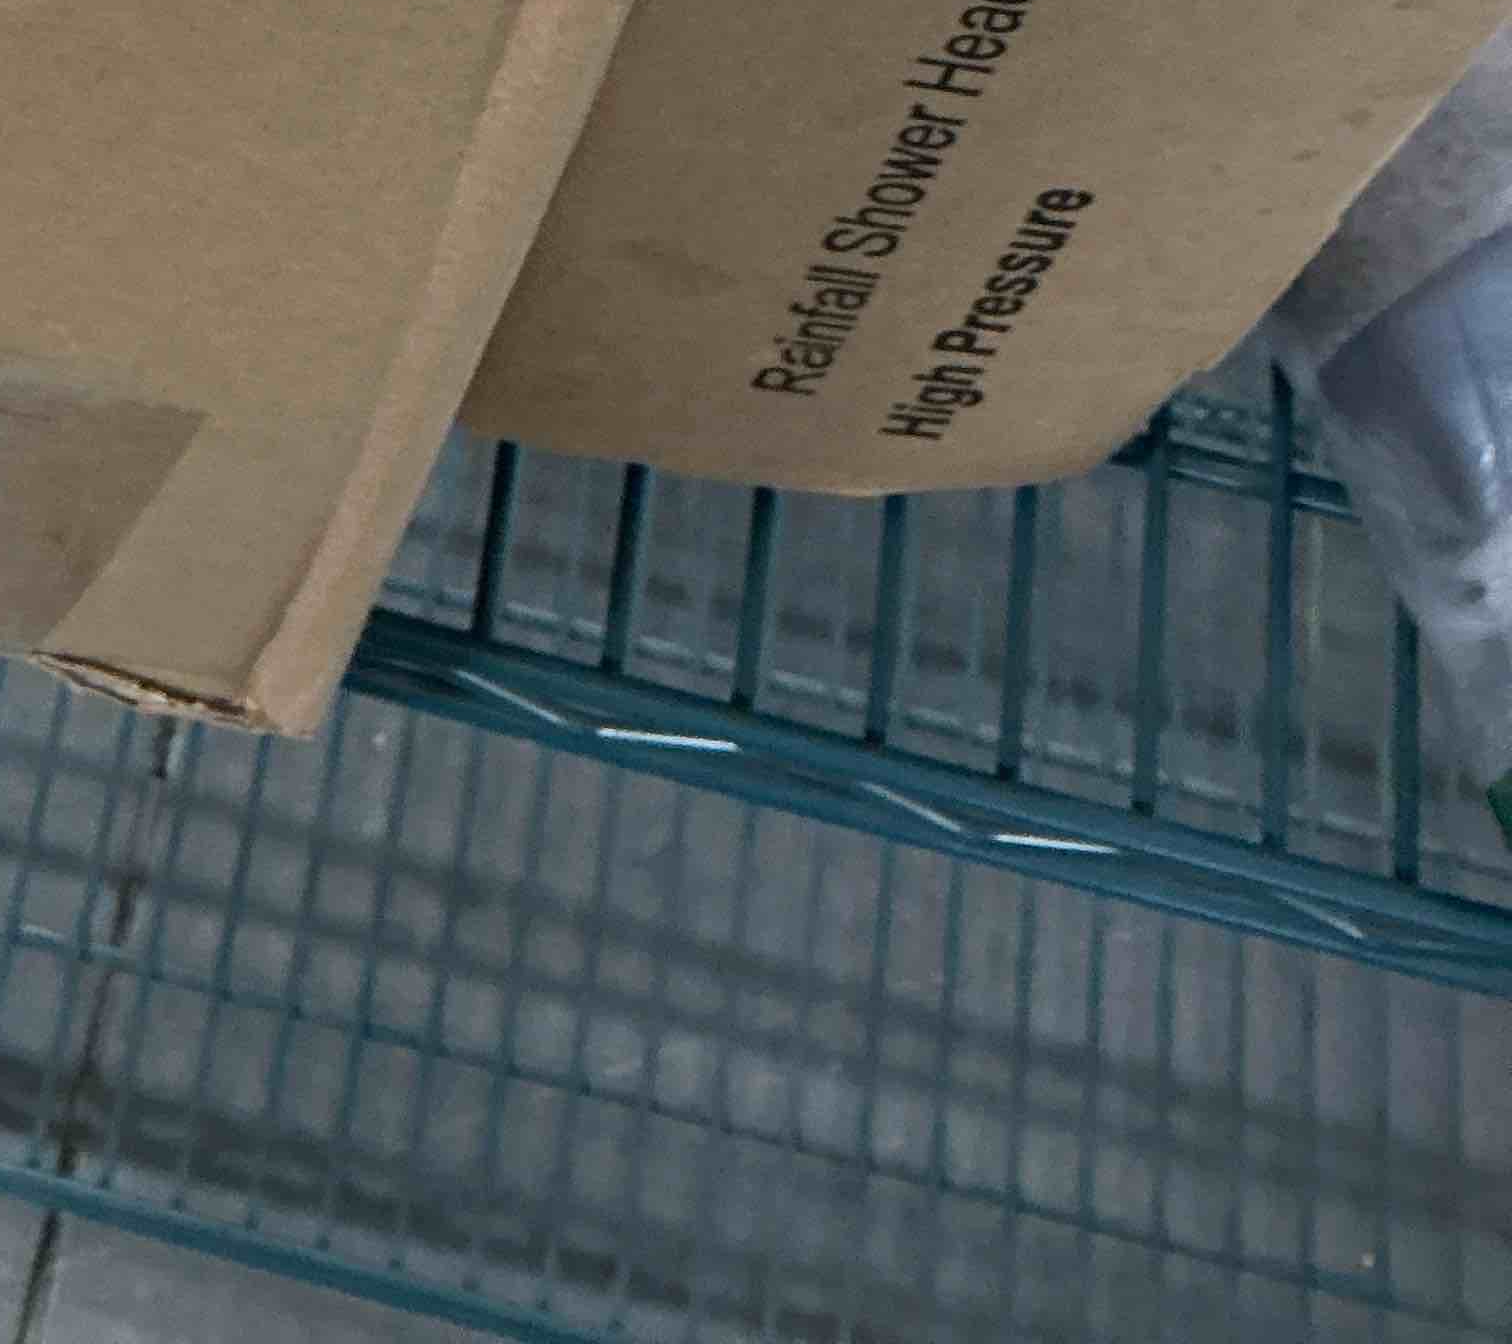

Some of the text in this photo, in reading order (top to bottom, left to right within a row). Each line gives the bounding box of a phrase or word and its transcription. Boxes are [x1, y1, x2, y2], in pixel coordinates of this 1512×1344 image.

[751, 264, 882, 397] Rainfall
[821, 102, 968, 259] Shower
[879, 186, 1098, 442] High Pressure
